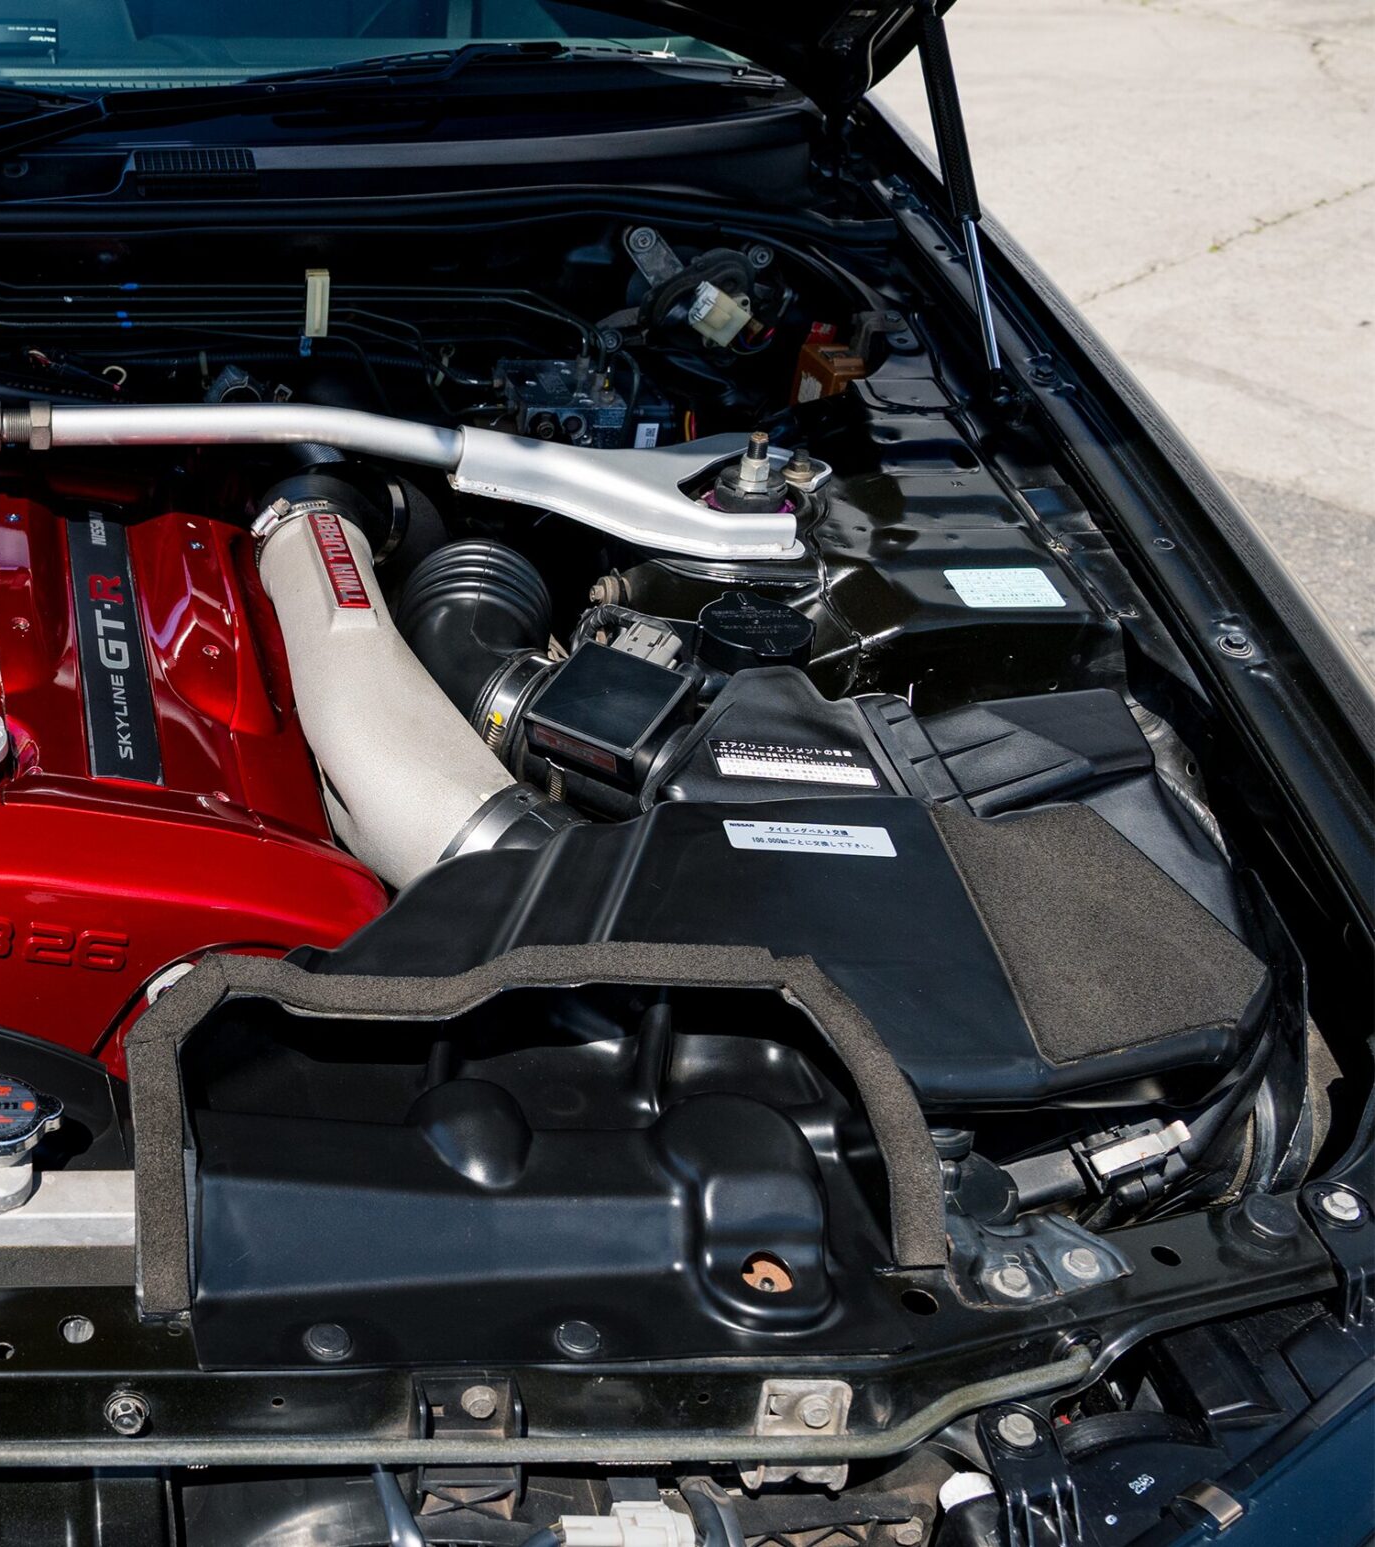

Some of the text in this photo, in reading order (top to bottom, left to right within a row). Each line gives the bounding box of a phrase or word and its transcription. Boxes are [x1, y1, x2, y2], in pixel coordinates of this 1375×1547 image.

[314, 513, 365, 602] TWIN TURBO
[110, 673, 134, 761] SKYLINE
[768, 826, 849, 836] タイミングベルト交換
[26, 921, 130, 972] 26
